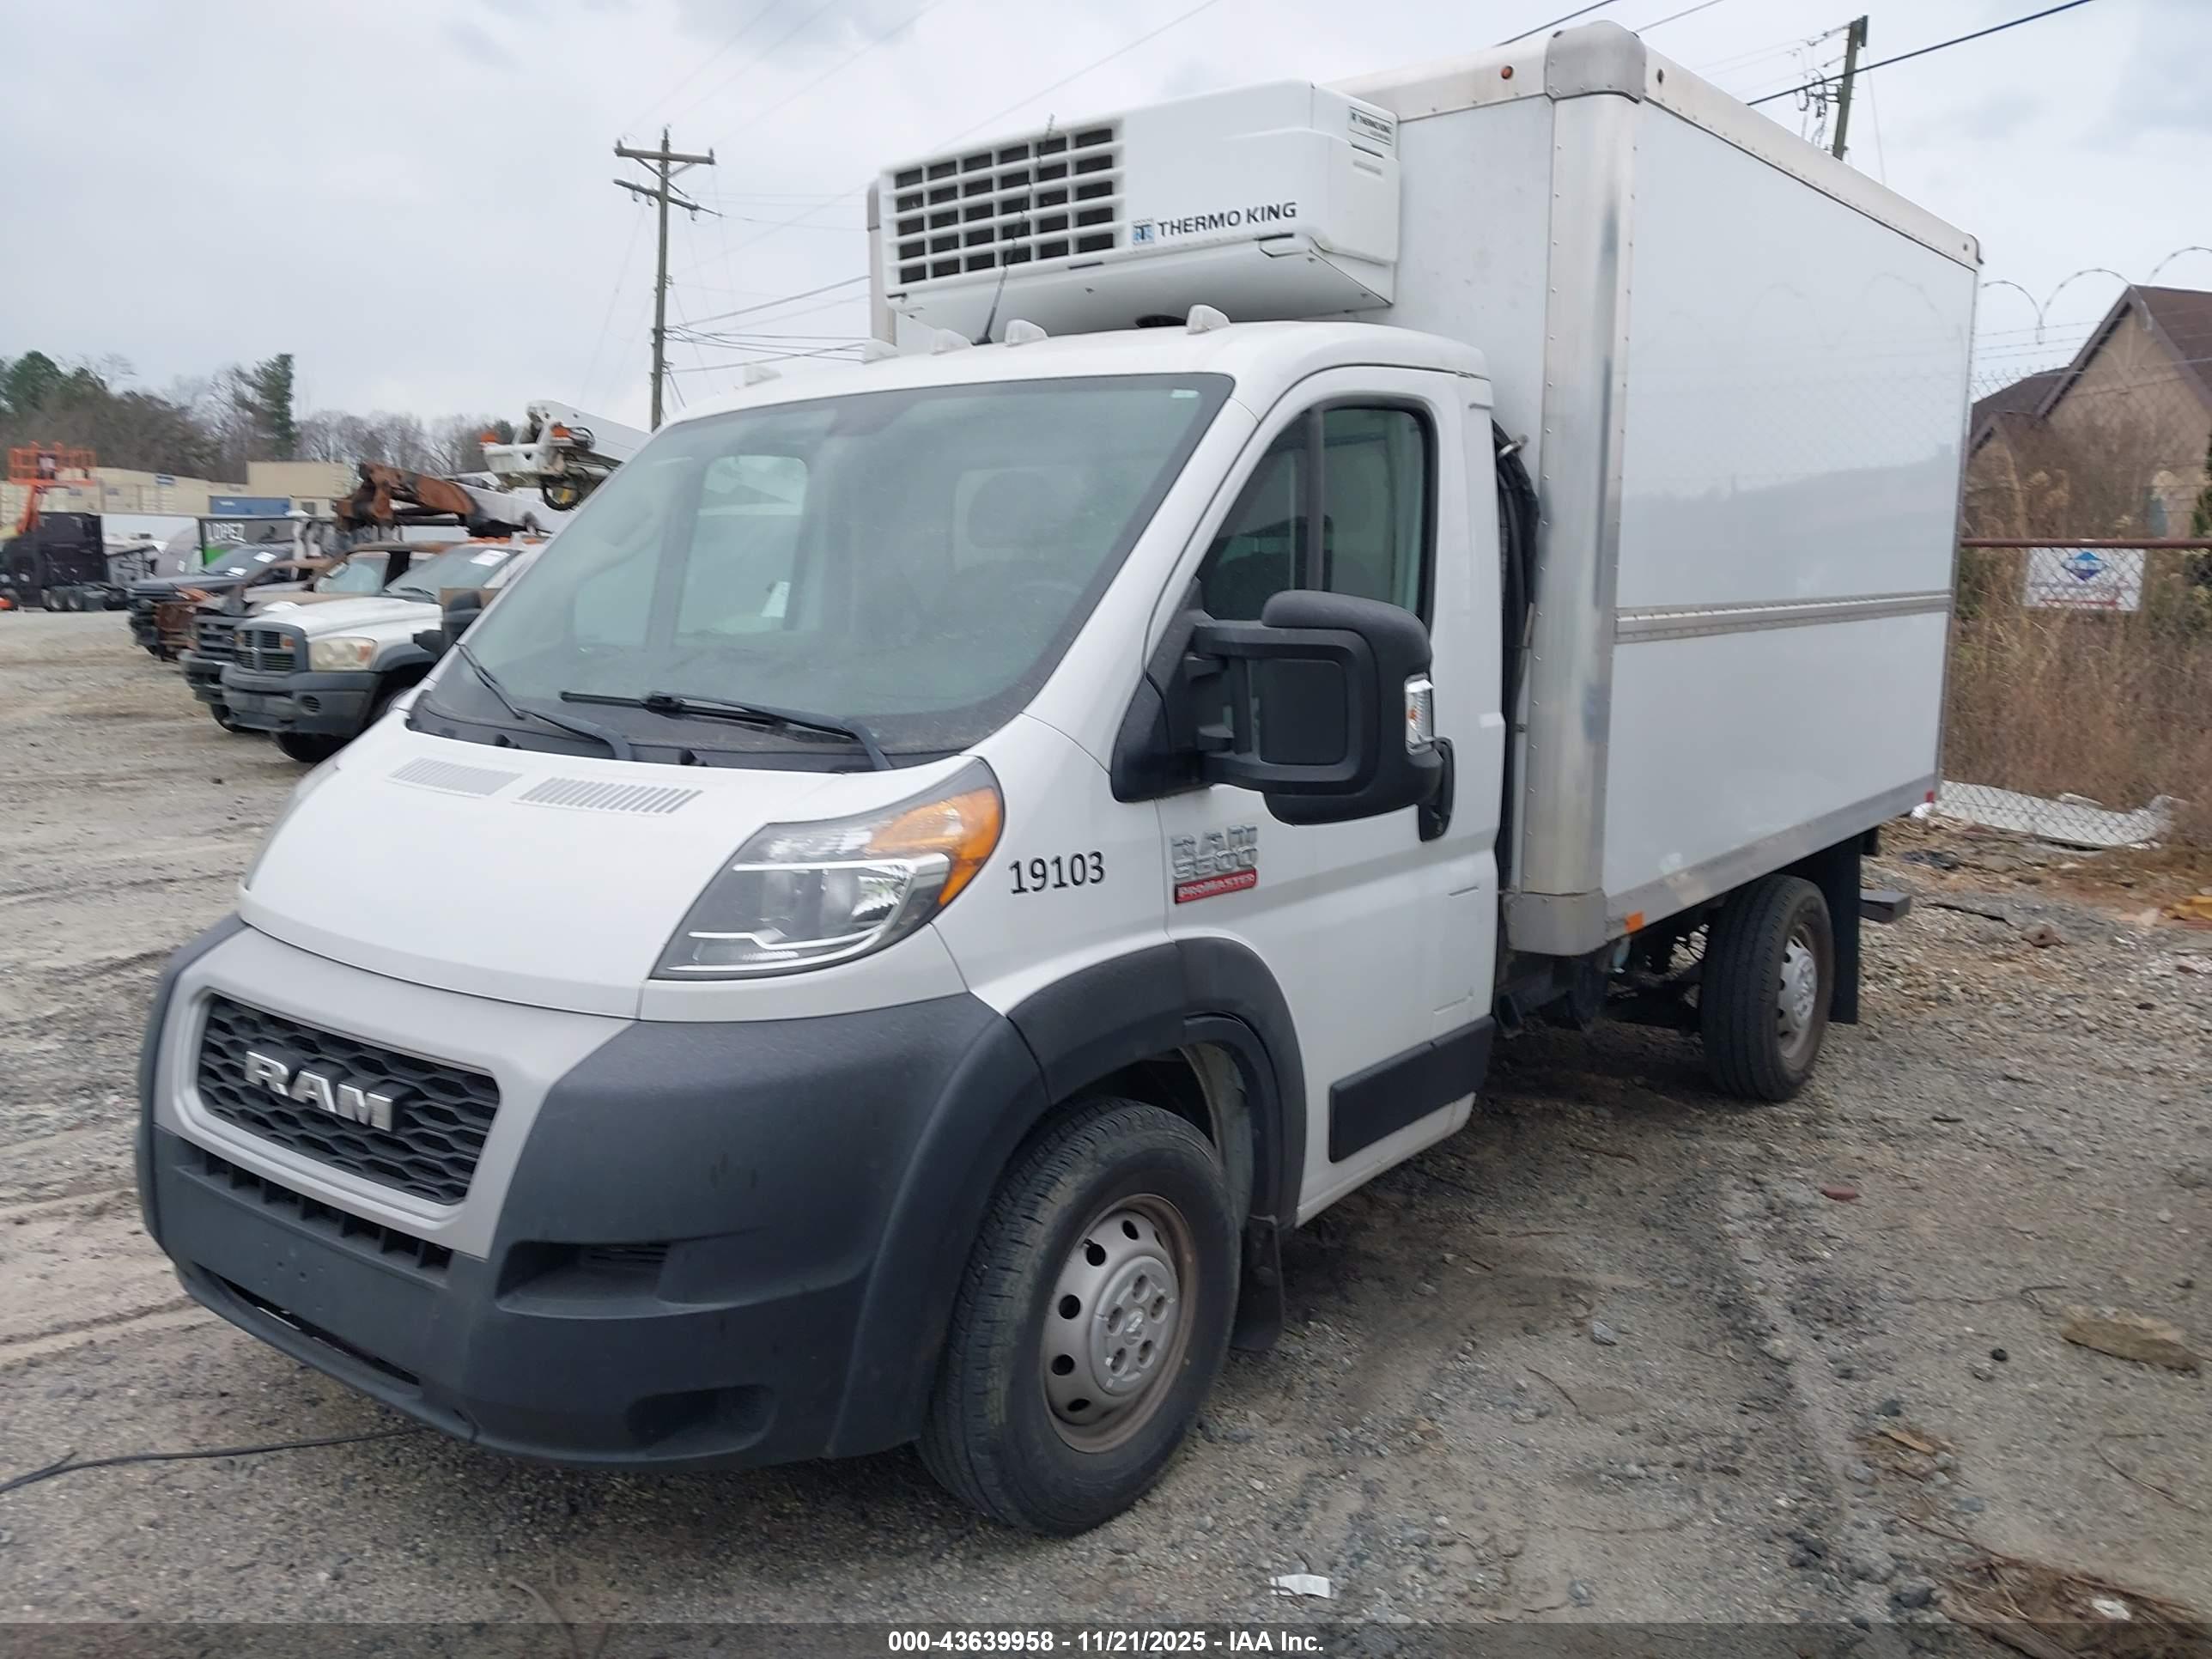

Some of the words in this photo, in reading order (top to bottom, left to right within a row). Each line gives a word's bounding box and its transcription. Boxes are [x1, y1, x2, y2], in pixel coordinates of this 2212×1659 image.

[1157, 210, 1241, 237] THERMO
[1246, 202, 1297, 223] KING
[1009, 851, 1105, 894] 19103
[245, 1050, 393, 1132] RAM
